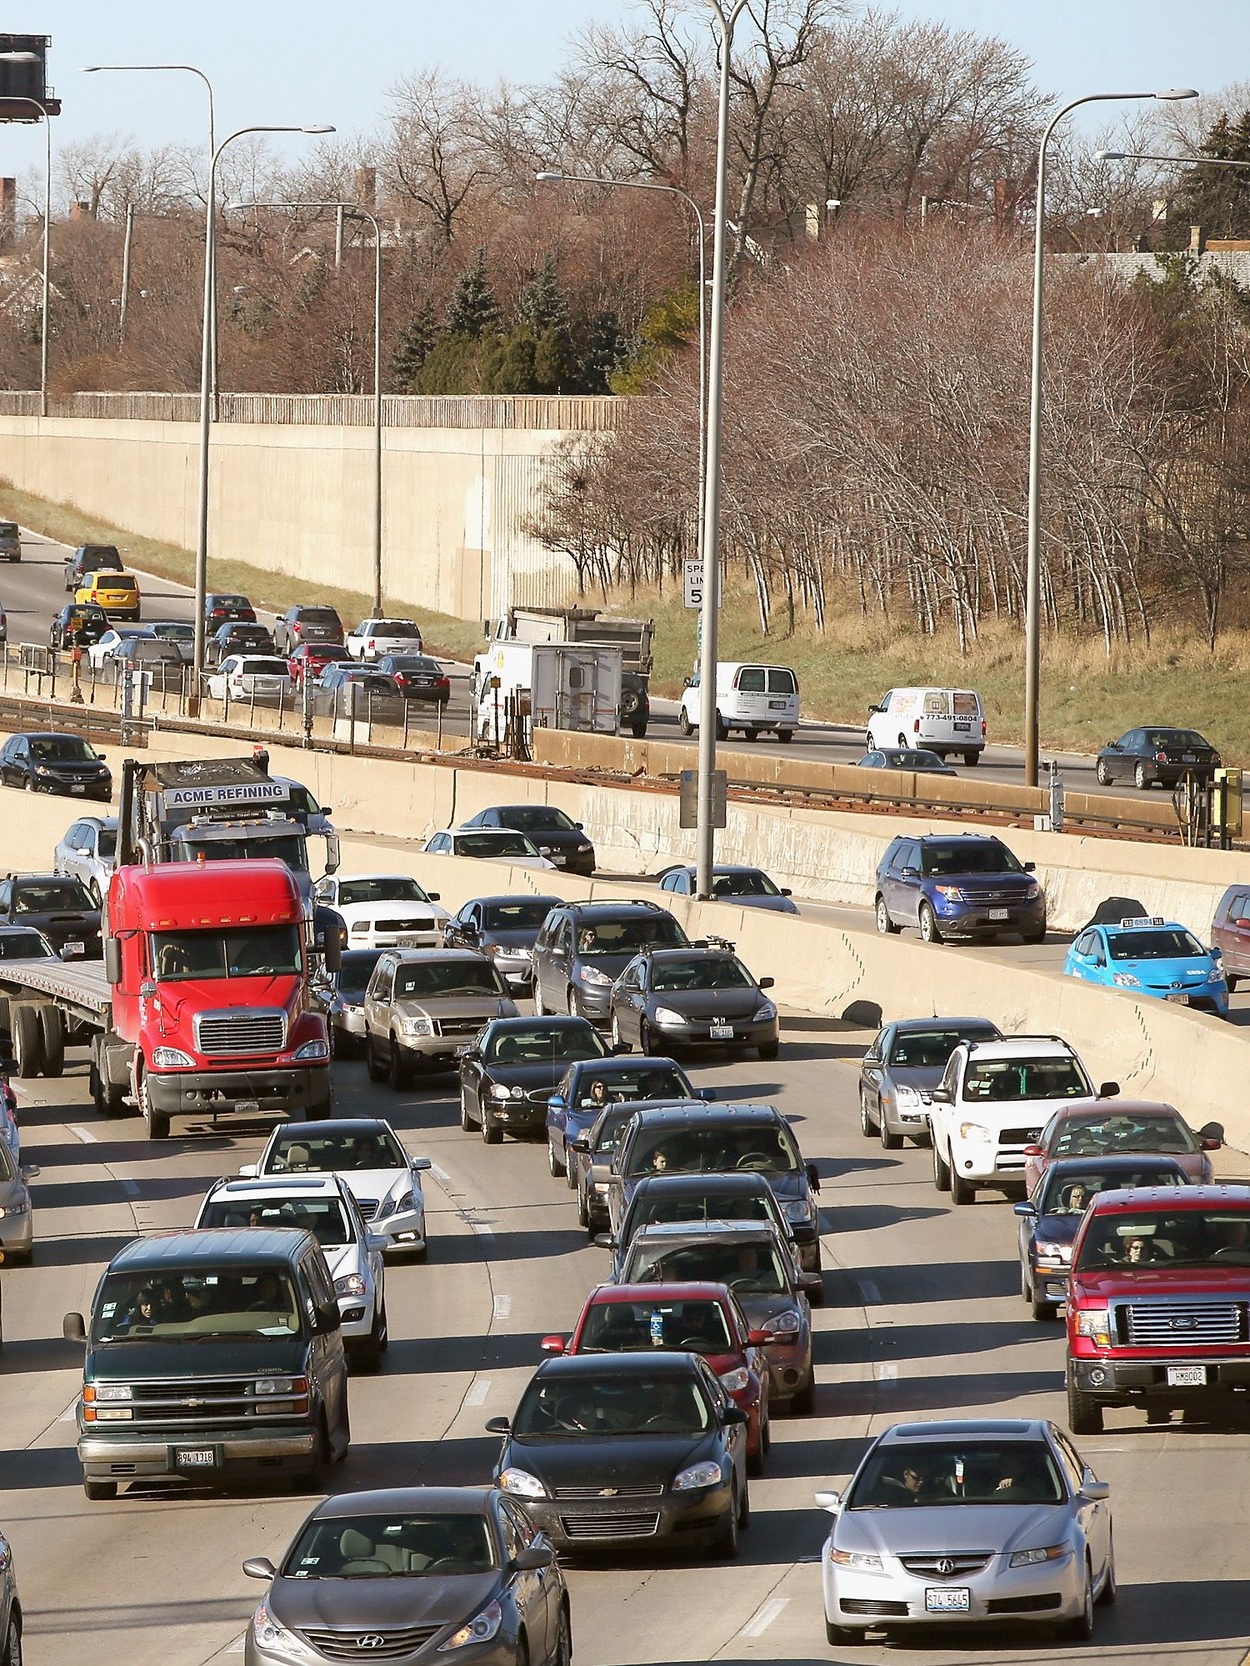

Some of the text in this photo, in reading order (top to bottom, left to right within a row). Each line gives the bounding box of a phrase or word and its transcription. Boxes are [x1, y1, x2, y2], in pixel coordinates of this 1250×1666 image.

[687, 565, 704, 573] SPE
[691, 589, 703, 603] 5
[173, 785, 283, 804] ACME REFINING
[195, 1452, 213, 1462] 1318
[927, 1594, 968, 1606] S74 5645
